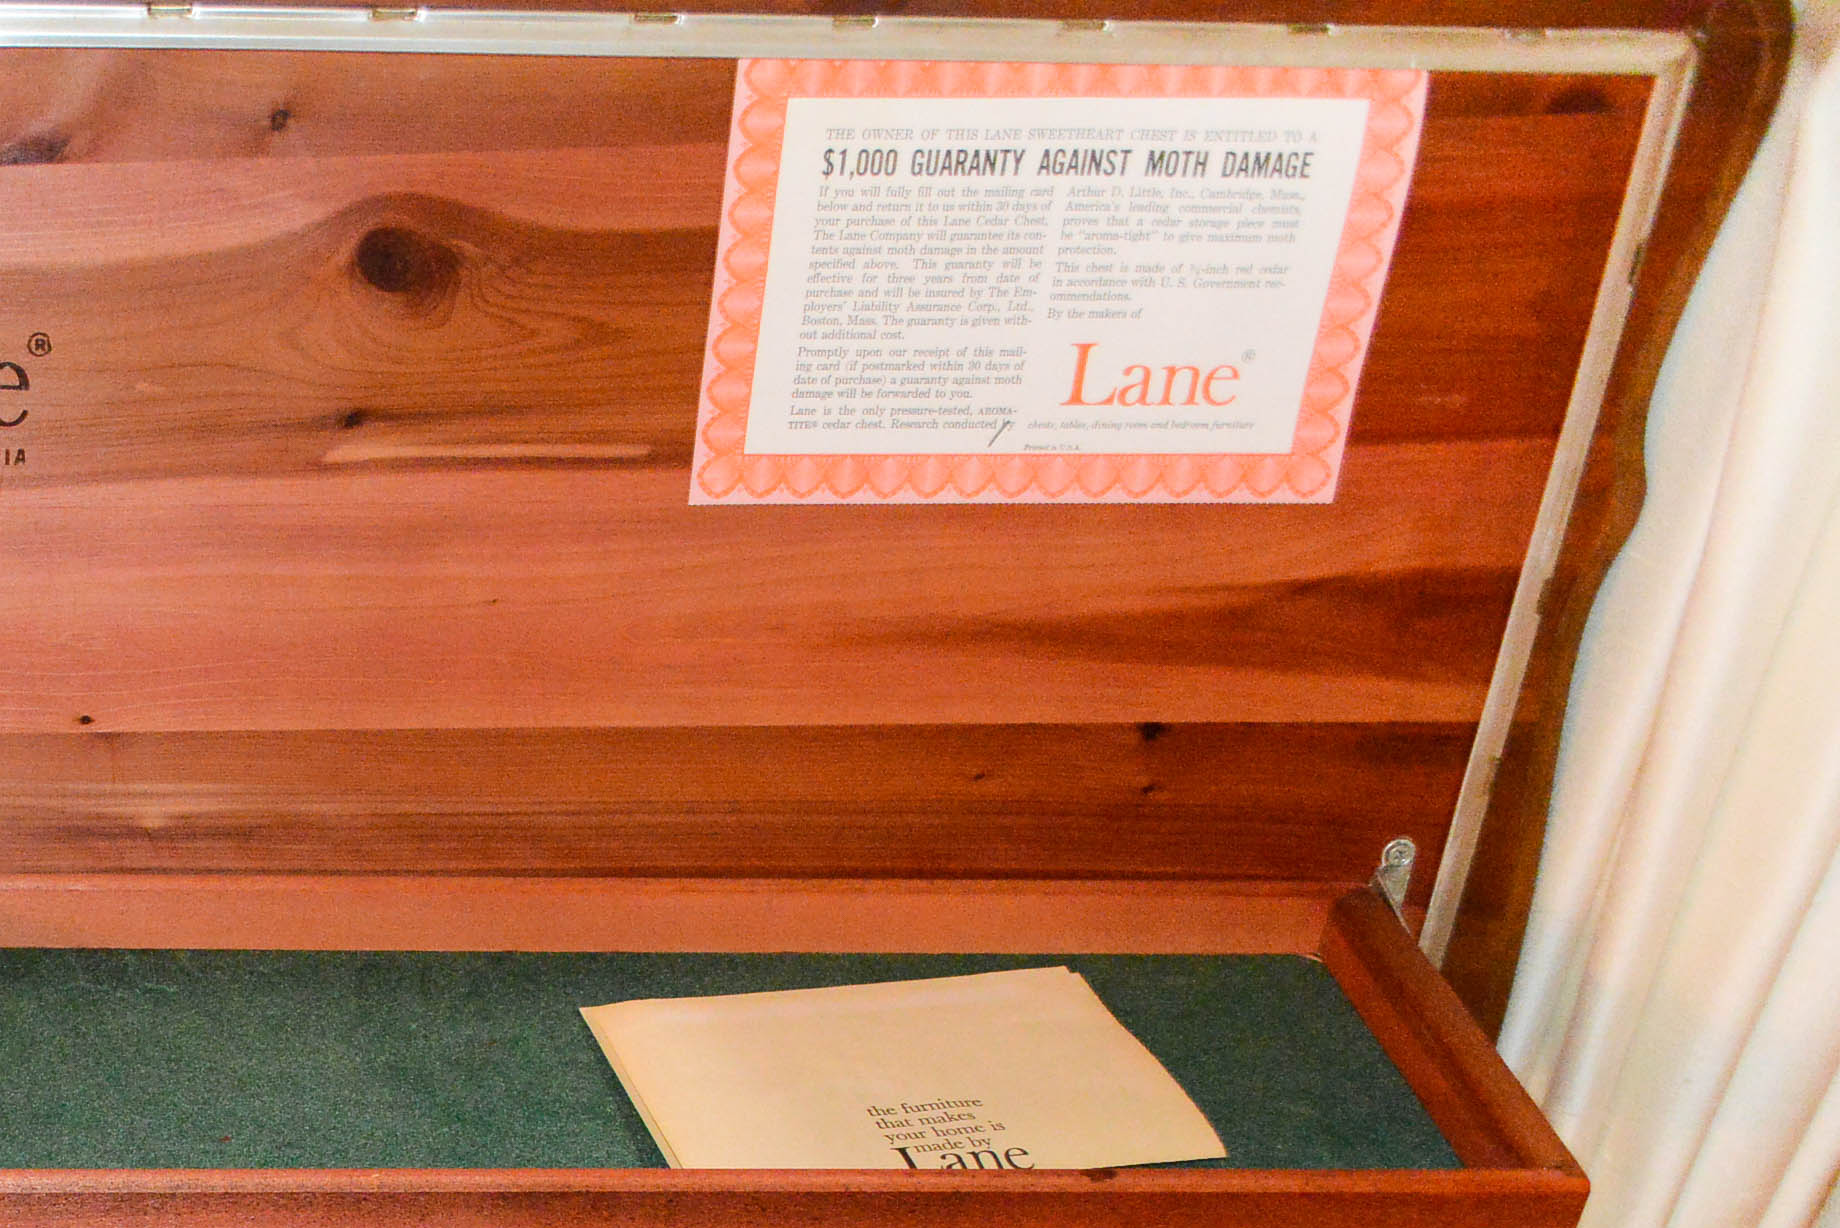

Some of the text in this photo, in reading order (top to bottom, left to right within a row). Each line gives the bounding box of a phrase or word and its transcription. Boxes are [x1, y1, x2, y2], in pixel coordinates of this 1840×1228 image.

[824, 128, 857, 140] THE
[861, 128, 915, 140] OWNER
[920, 128, 940, 140] OF
[945, 128, 980, 140] THIS
[984, 129, 1023, 141] LANE
[1130, 129, 1178, 141] CHEST
[820, 149, 1315, 178] $1,000 GUARANTY AGAINST MOTH DAMAGE
[818, 186, 829, 196] If
[833, 188, 856, 199] you
[859, 186, 881, 196] will
[916, 186, 933, 196] fill
[936, 186, 956, 196] out
[960, 186, 980, 196] the
[983, 186, 1026, 199] mailing
[1029, 186, 1055, 196] card
[815, 200, 849, 211] below
[850, 200, 872, 211] and
[876, 200, 912, 211] return
[914, 200, 925, 211] it
[927, 200, 940, 211] to
[958, 200, 994, 211] within
[996, 200, 1010, 211] 30
[1012, 200, 1038, 214] days
[1040, 200, 1052, 211] of
[814, 218, 841, 229] your
[845, 215, 896, 228] purchase
[899, 215, 912, 225] of
[916, 215, 939, 225] this
[942, 215, 972, 225] Lane
[812, 230, 836, 240] The
[838, 230, 867, 240] Lane
[868, 230, 924, 243] Company
[926, 230, 948, 240] will
[949, 230, 1004, 243] guarantee
[1024, 232, 1046, 240] con-
[808, 258, 857, 272] specified
[862, 258, 900, 269] above.
[911, 258, 938, 269] This
[1001, 258, 1022, 269] will
[806, 272, 1040, 286] effective for three years from date of
[804, 287, 854, 300] purchase
[857, 287, 879, 297] and
[882, 287, 904, 297] will
[924, 286, 966, 297] insured
[968, 286, 984, 300] by
[986, 286, 1010, 297] The
[1013, 286, 1037, 297] Em-
[851, 301, 900, 314] Liability
[906, 301, 962, 311] Assurance
[802, 315, 842, 327] Boston,
[881, 315, 905, 325] The
[960, 315, 970, 325] is
[1003, 315, 1032, 325] with-
[798, 329, 906, 340] out additional cost.
[796, 346, 1027, 360] Promptly upon our receipt of this mail-
[794, 361, 814, 374] ing
[815, 360, 841, 371] card
[861, 360, 926, 374] postmarked
[928, 360, 965, 370] within
[967, 360, 982, 370] 30
[984, 360, 1011, 373] days
[1013, 360, 1025, 370] of
[792, 374, 819, 384] date
[819, 374, 832, 384] of
[834, 374, 886, 387] purchase)
[890, 376, 898, 384] a
[951, 374, 992, 387] against
[993, 374, 1023, 384] moth
[790, 388, 835, 401] damage
[836, 388, 857, 398] will
[876, 388, 932, 398] forwarded
[934, 388, 947, 398] to
[867, 1098, 983, 1118] the furniture
[876, 1111, 976, 1130] that makes
[883, 1120, 1006, 1145] your home is
[911, 1136, 992, 1154] made by
